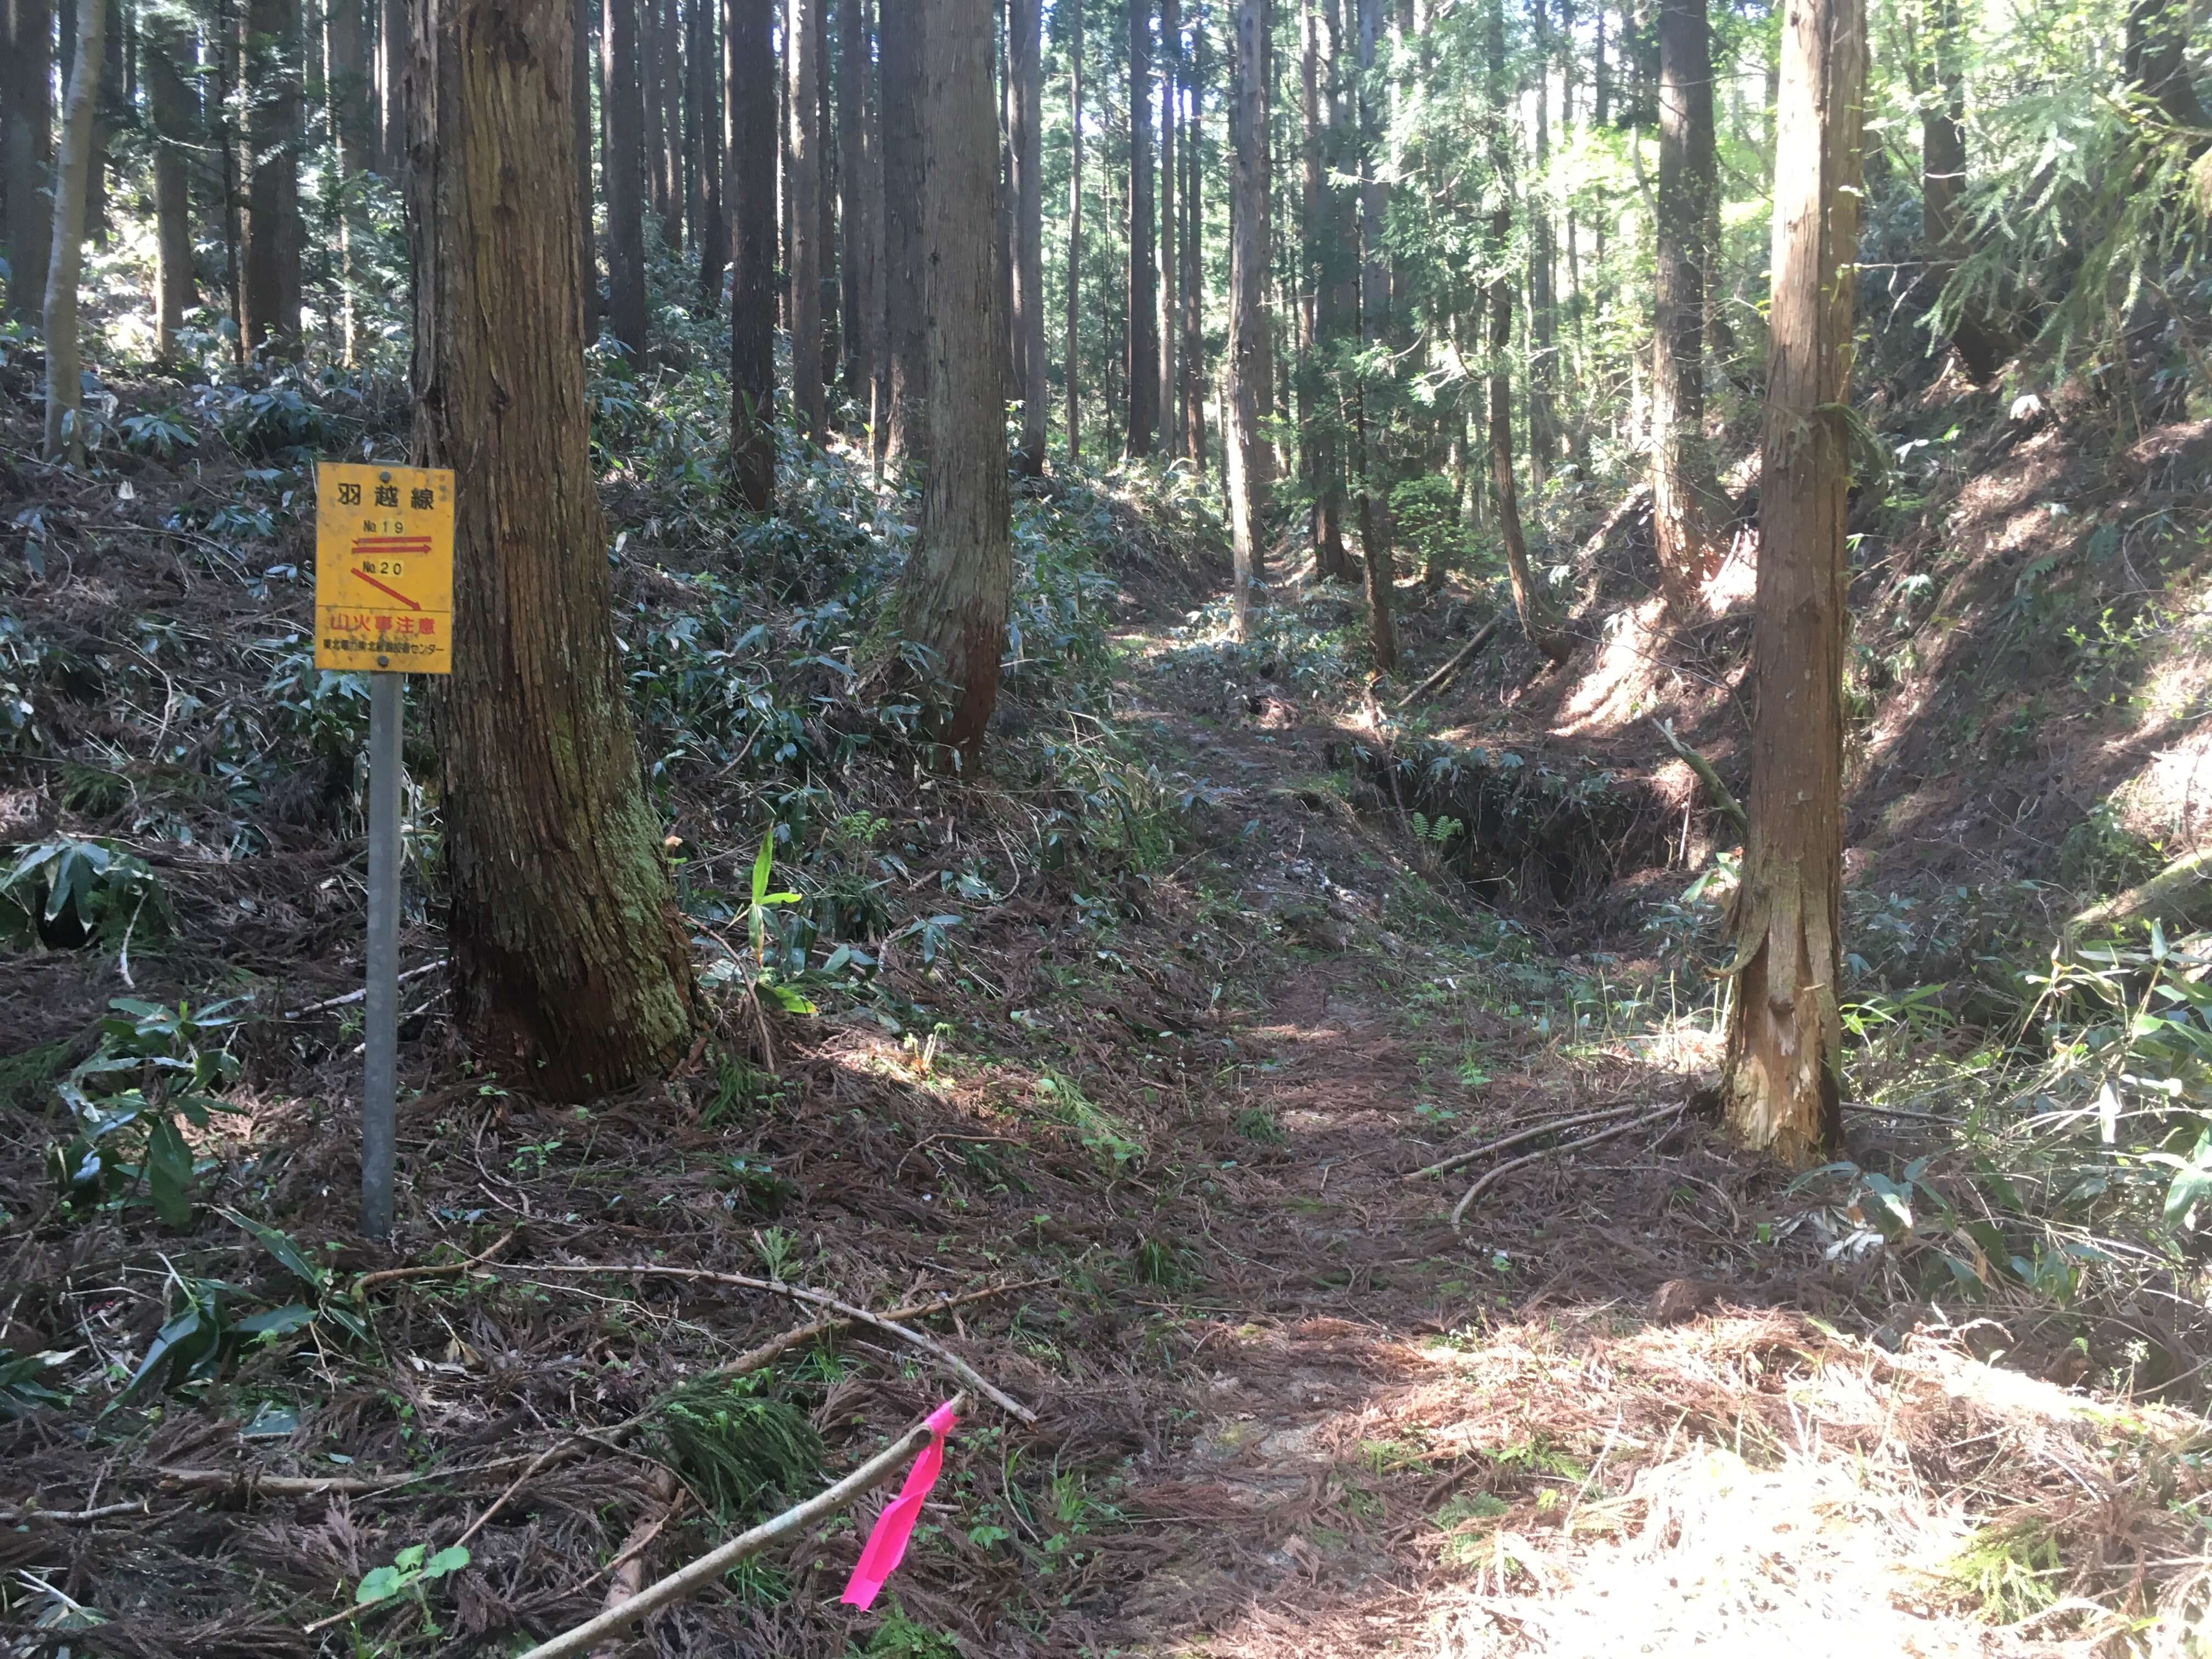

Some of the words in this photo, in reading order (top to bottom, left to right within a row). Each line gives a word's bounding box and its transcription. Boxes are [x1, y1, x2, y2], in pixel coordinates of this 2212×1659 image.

[337, 483, 434, 510] 羽越線
[330, 613, 435, 635] 山火事注意
